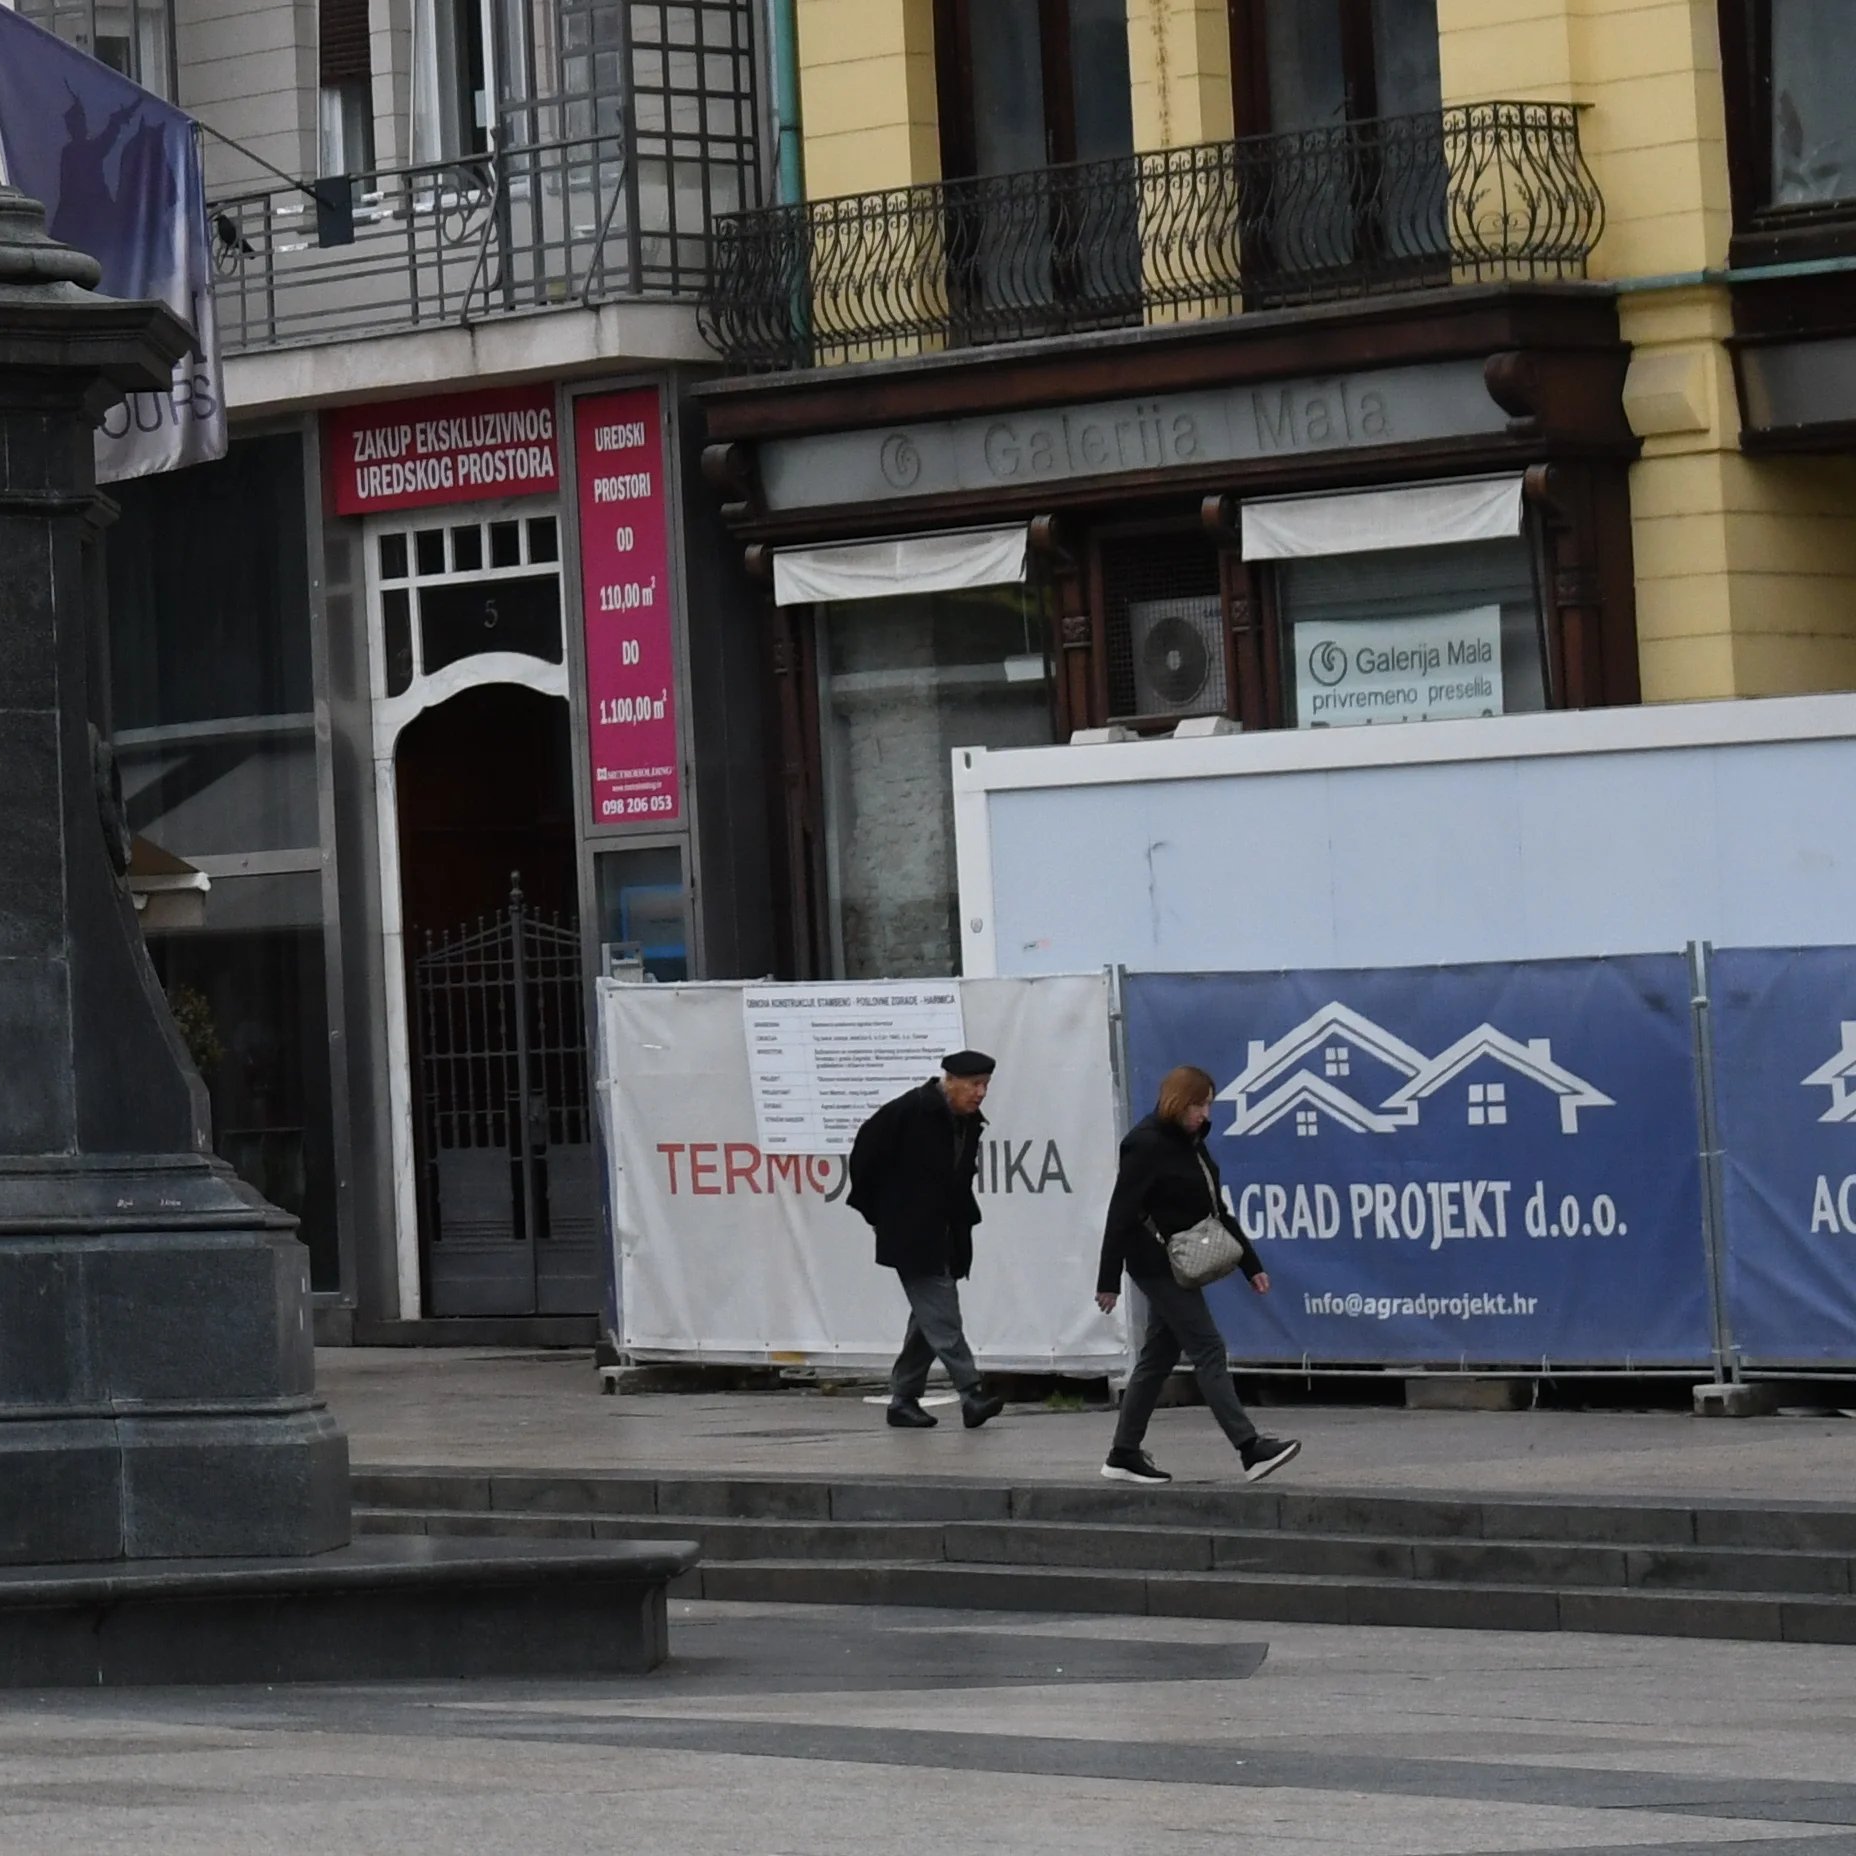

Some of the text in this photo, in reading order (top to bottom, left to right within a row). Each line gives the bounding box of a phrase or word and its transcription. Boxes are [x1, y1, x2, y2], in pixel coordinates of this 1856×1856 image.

[100, 374, 216, 440] OURS
[352, 408, 553, 462] ZAKUP EKSKLUZIVNOG
[594, 421, 645, 452] UREDSKI
[983, 380, 1390, 478] Galerija Mala
[356, 446, 555, 499] UREDSKOG PROSTORA
[593, 472, 651, 503] PROSTORI
[616, 526, 634, 552] OD
[600, 582, 640, 613] 110,00
[484, 599, 498, 628] 5
[622, 639, 639, 665] DO
[1355, 637, 1492, 677] Galerija Mala
[600, 695, 651, 726] 1.100,00
[1312, 676, 1493, 715] privremeno preselila
[602, 794, 673, 815] 098 206 053
[1349, 1180, 1511, 1250] PROJEKT
[1524, 1180, 1628, 1238] d.o.o.
[1304, 1292, 1538, 1320] info@agradprojekt.hr
